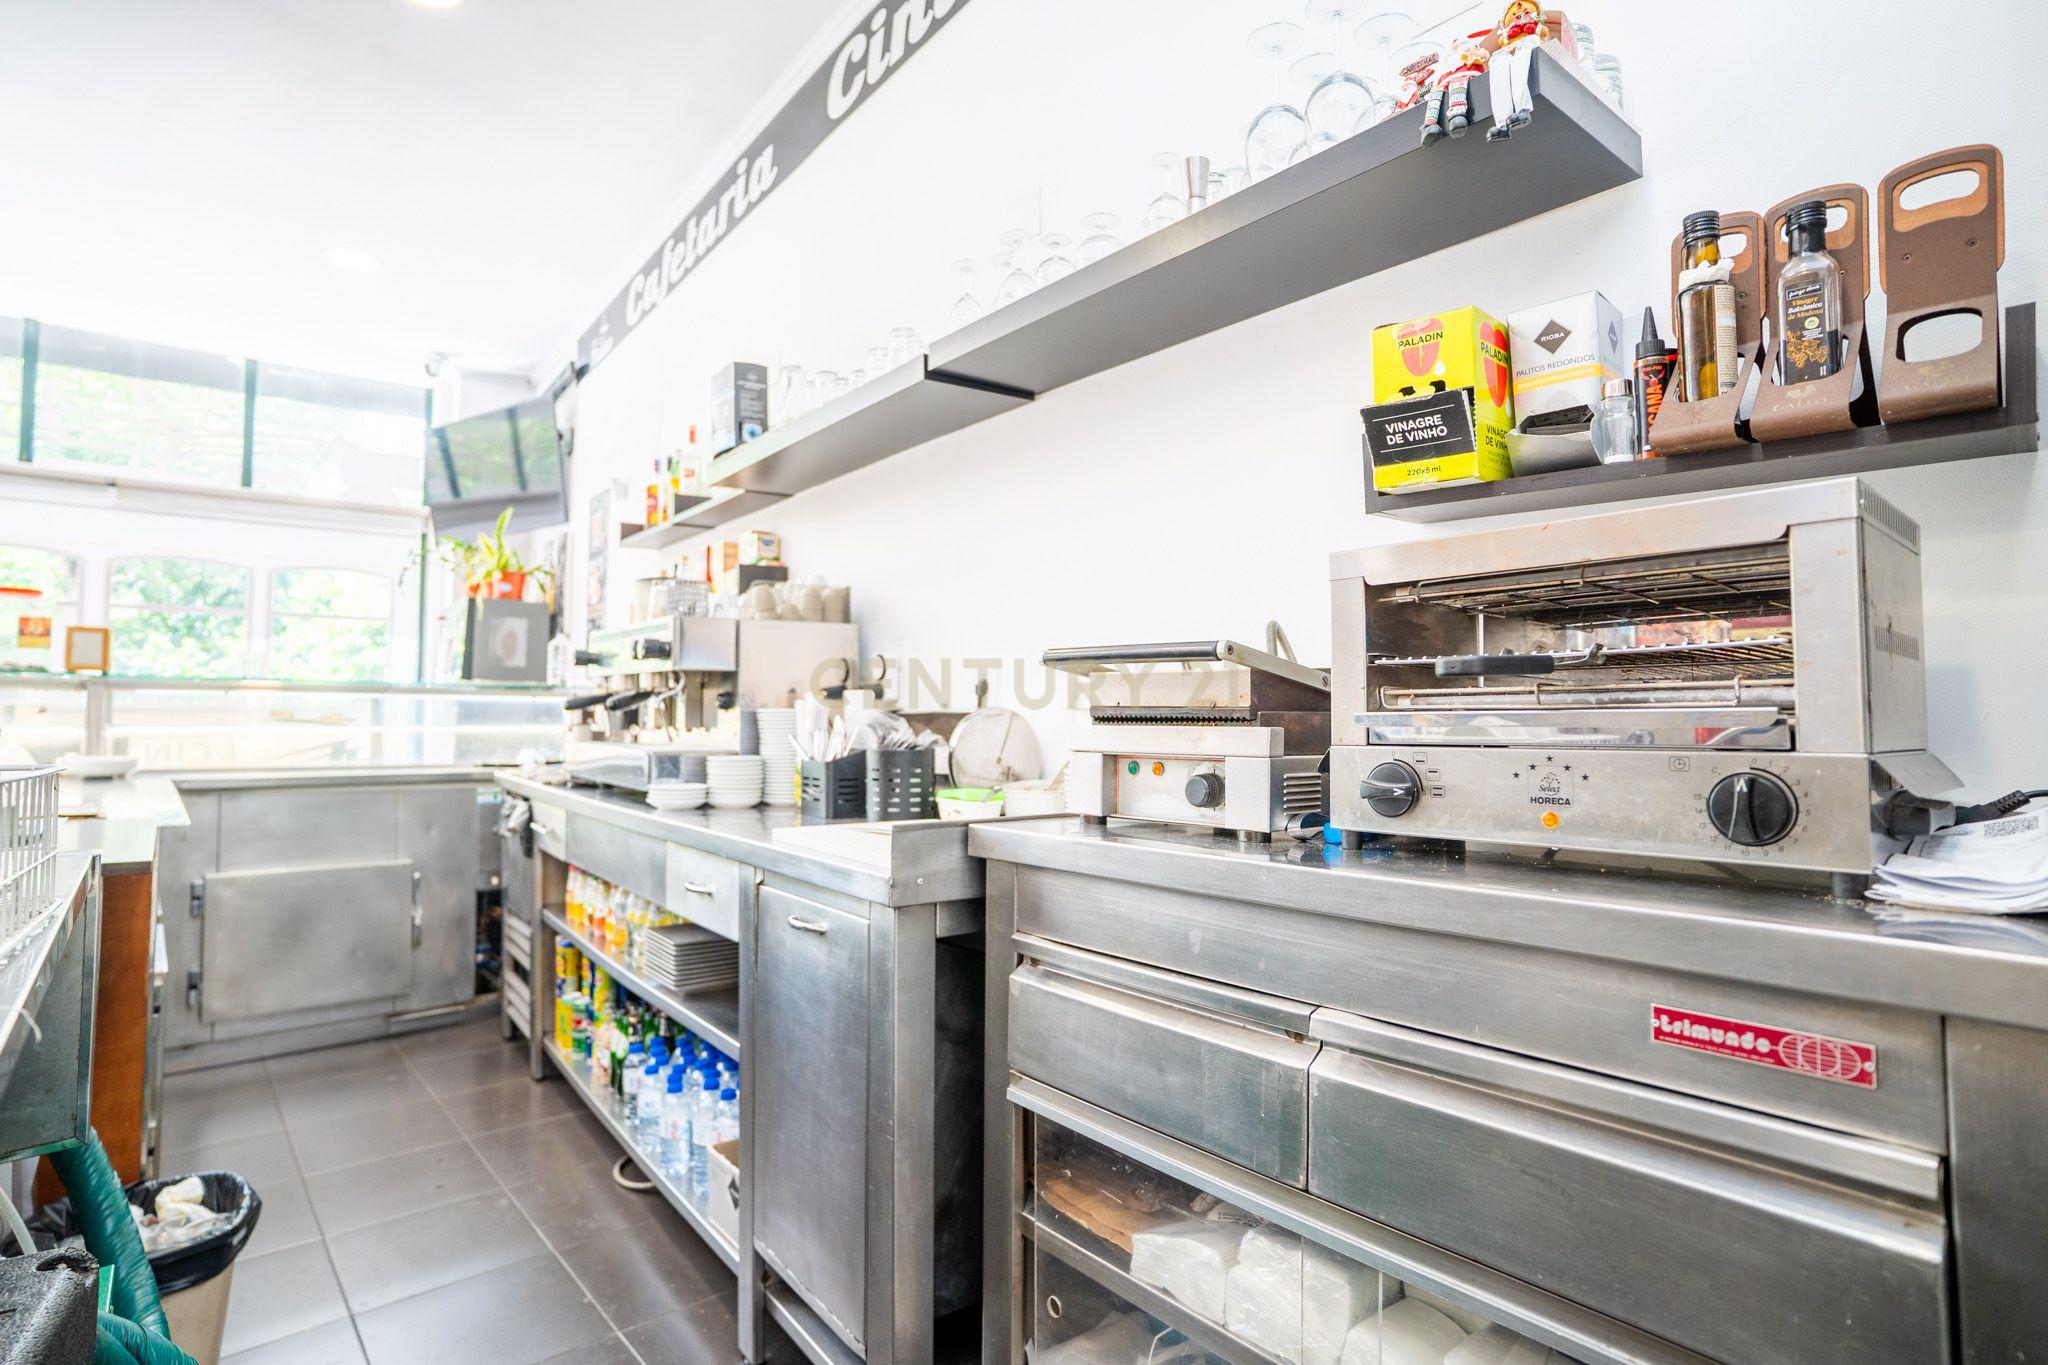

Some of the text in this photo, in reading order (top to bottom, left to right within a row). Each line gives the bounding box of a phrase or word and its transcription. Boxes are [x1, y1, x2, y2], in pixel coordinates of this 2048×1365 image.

[625, 0, 956, 326] Cafetaria Cin
[1398, 331, 1443, 348] PALADIN
[1541, 331, 1565, 342] RIOBA
[1480, 342, 1509, 367] PALADIN
[1516, 354, 1595, 377] PALITOS REDONDOS
[1385, 414, 1443, 434] VINAGRE
[1386, 425, 1448, 446] DE VINHO
[1485, 435, 1508, 451] DE VINH
[1539, 784, 1560, 793] Select
[1530, 796, 1571, 806] HORECA
[1660, 1014, 1771, 1054] trimundo
